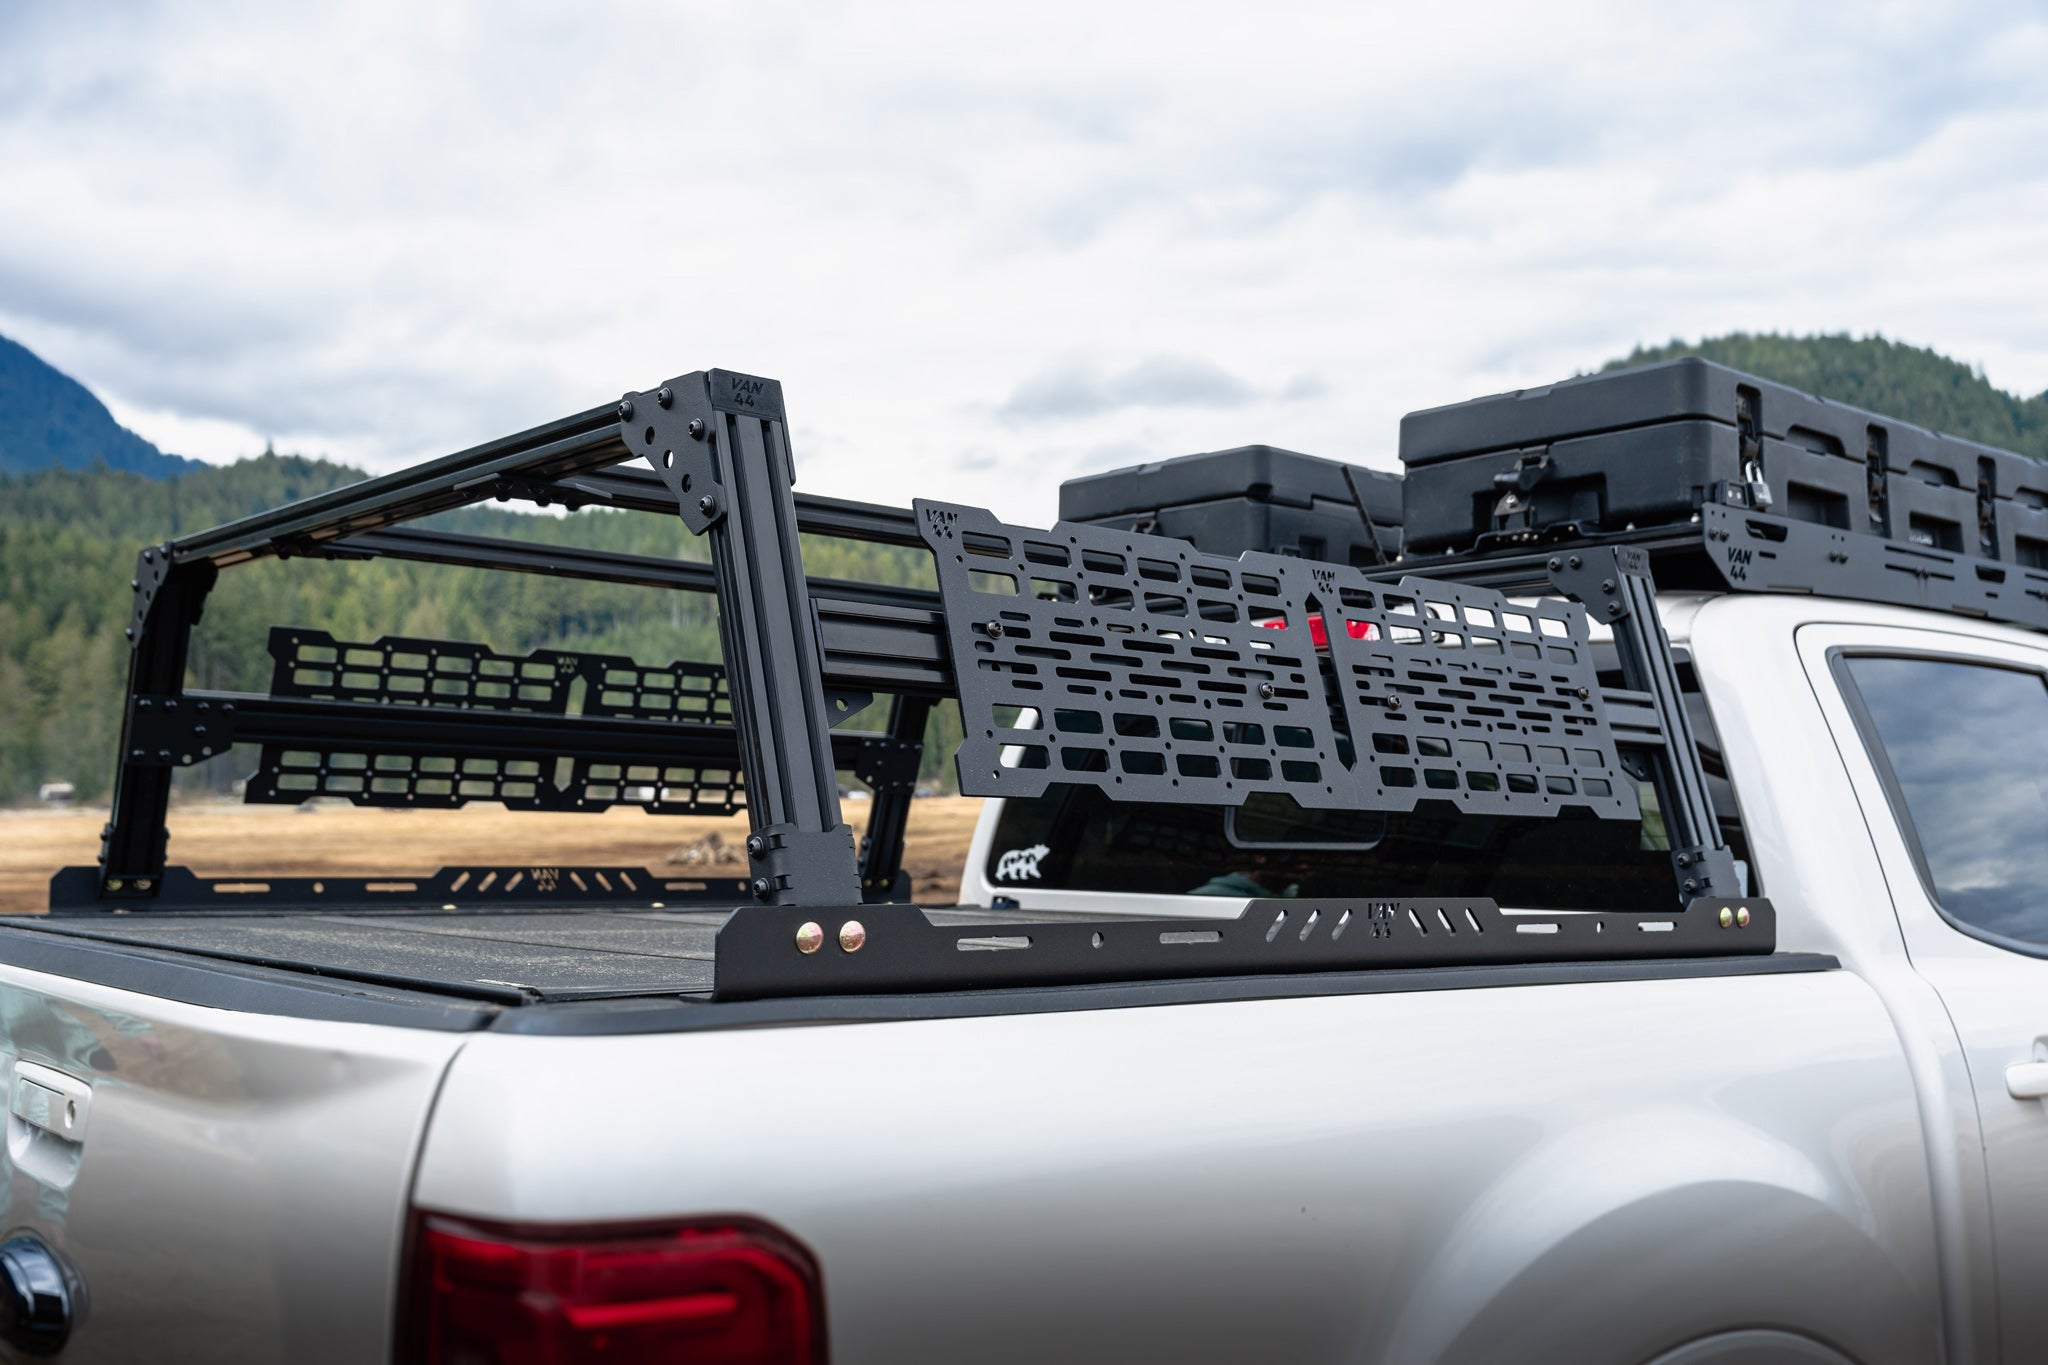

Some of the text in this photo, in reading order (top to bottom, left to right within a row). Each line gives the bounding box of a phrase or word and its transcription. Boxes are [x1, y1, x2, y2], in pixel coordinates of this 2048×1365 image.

[732, 377, 763, 394] VAN
[734, 392, 755, 407] 44
[926, 509, 958, 525] VAN
[1728, 547, 1752, 565] VAN
[1312, 569, 1335, 582] VAN
[1730, 565, 1746, 581] 44
[1368, 903, 1400, 920] VAN
